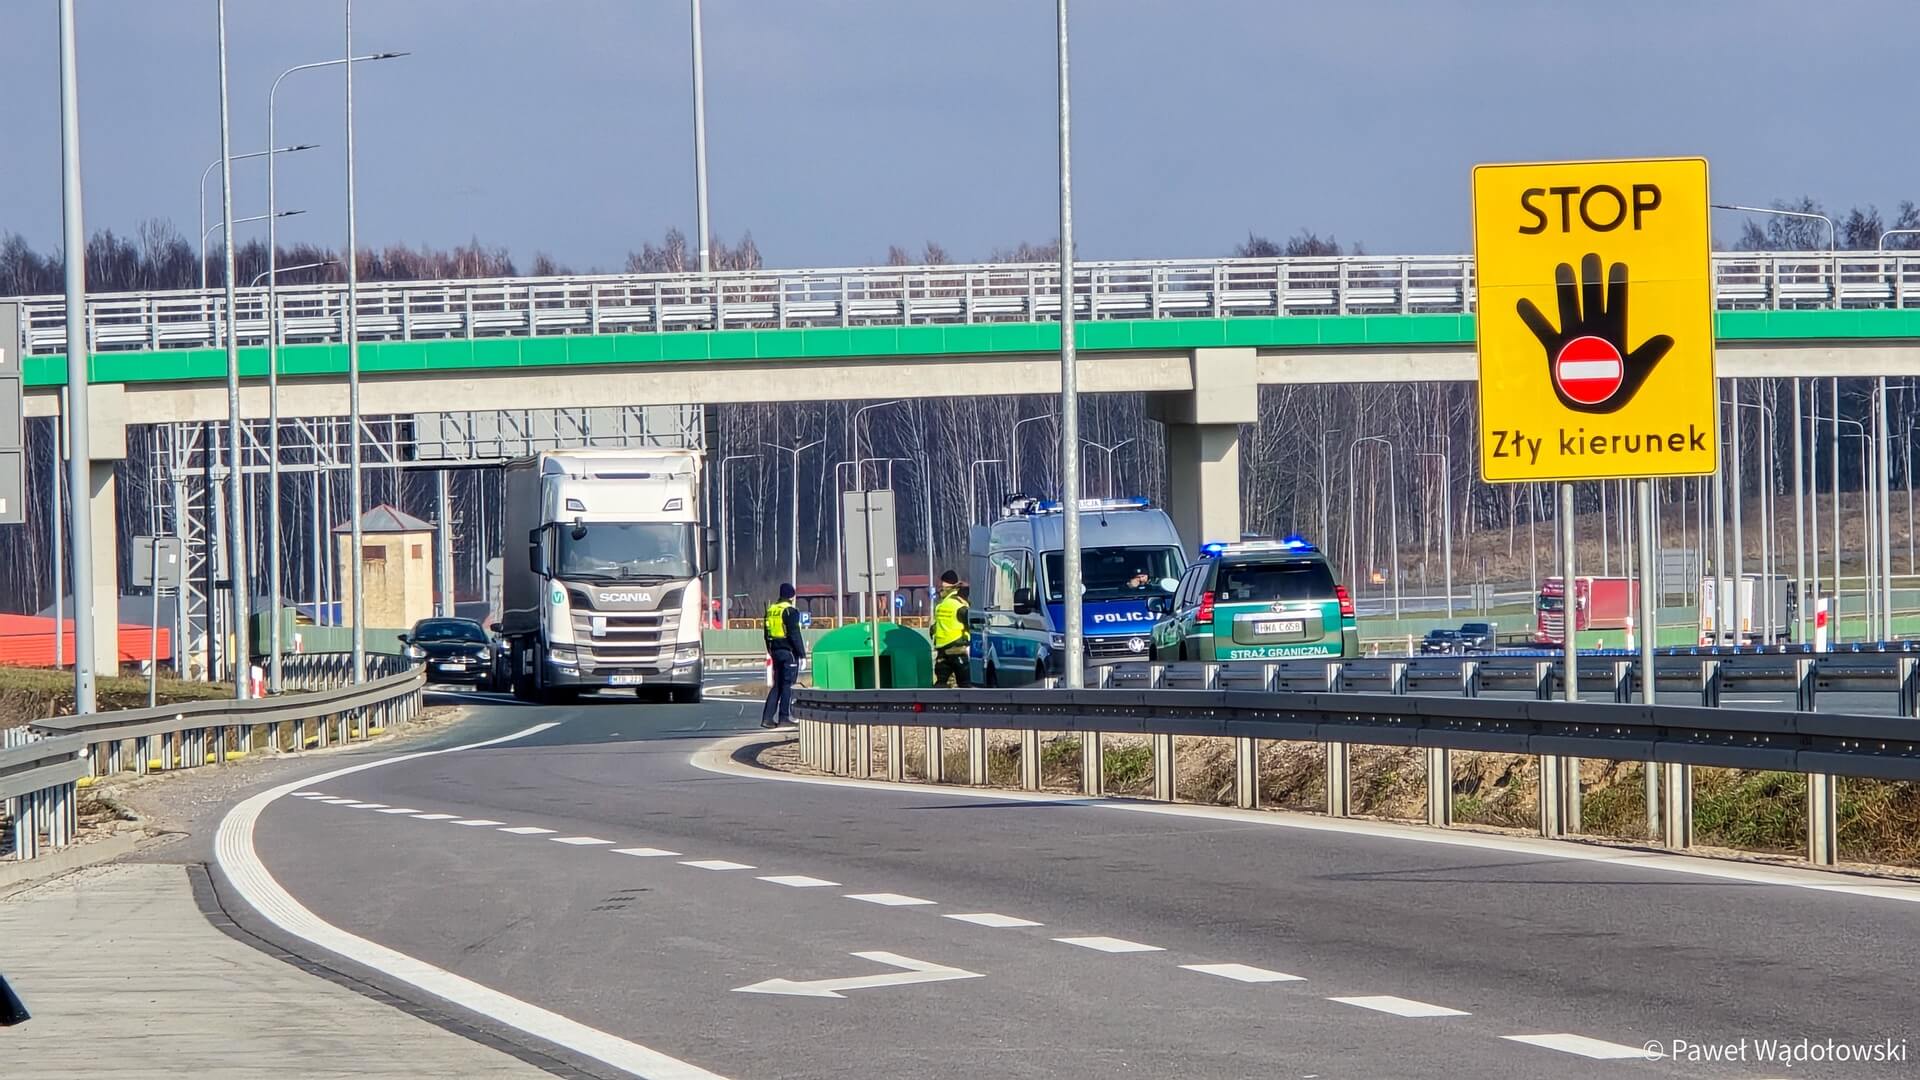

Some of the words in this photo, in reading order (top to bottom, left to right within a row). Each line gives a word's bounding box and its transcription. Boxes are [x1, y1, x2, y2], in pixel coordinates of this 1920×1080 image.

[1518, 184, 1662, 235] STOP
[1492, 430, 1542, 465] Zły
[1559, 424, 1707, 456] kierunek
[599, 592, 653, 602] SCANIA
[1230, 648, 1266, 659] STRAŻ
[1267, 646, 1329, 657] GRANICZNA
